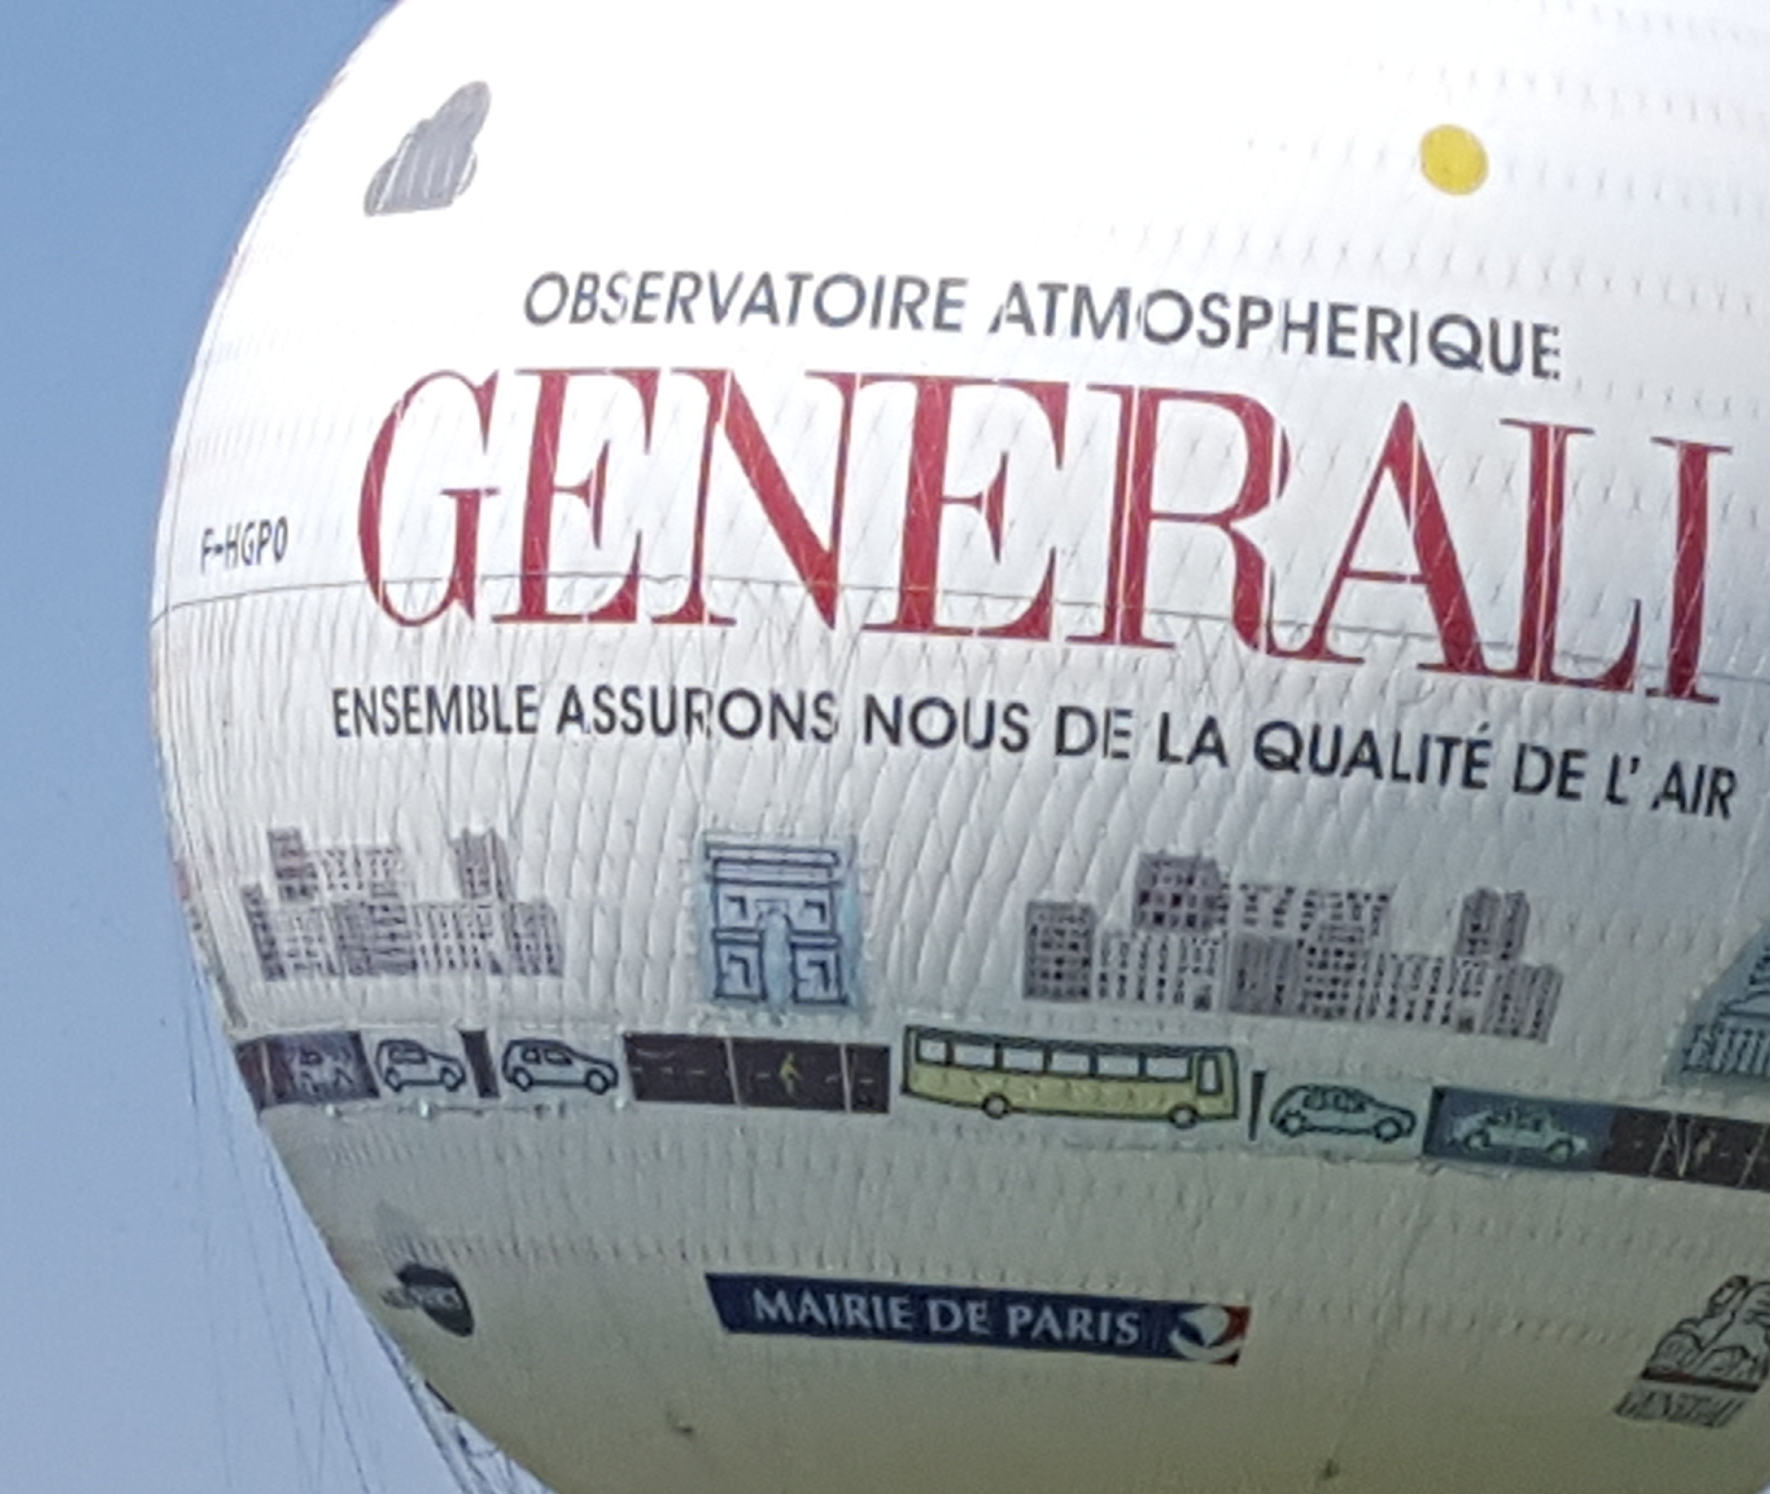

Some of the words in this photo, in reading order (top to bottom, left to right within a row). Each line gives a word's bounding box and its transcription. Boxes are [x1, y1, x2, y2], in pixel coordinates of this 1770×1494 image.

[524, 270, 969, 333] OBSERVATOIRE
[987, 279, 1563, 381] ATMOSPHERIQUE
[356, 367, 1733, 704] GENERALI
[331, 684, 539, 738] ENSEMBLE
[555, 684, 837, 745] ASSURONS
[863, 692, 1031, 754] NOUS
[1054, 706, 1133, 760] DE
[1157, 711, 1230, 768] LA
[1253, 720, 1493, 790] QUALITÉ
[1512, 740, 1589, 800] DE
[752, 1288, 914, 1332] MAIRIE
[931, 1299, 991, 1336] DE
[1007, 1303, 1142, 1346] PARIS
